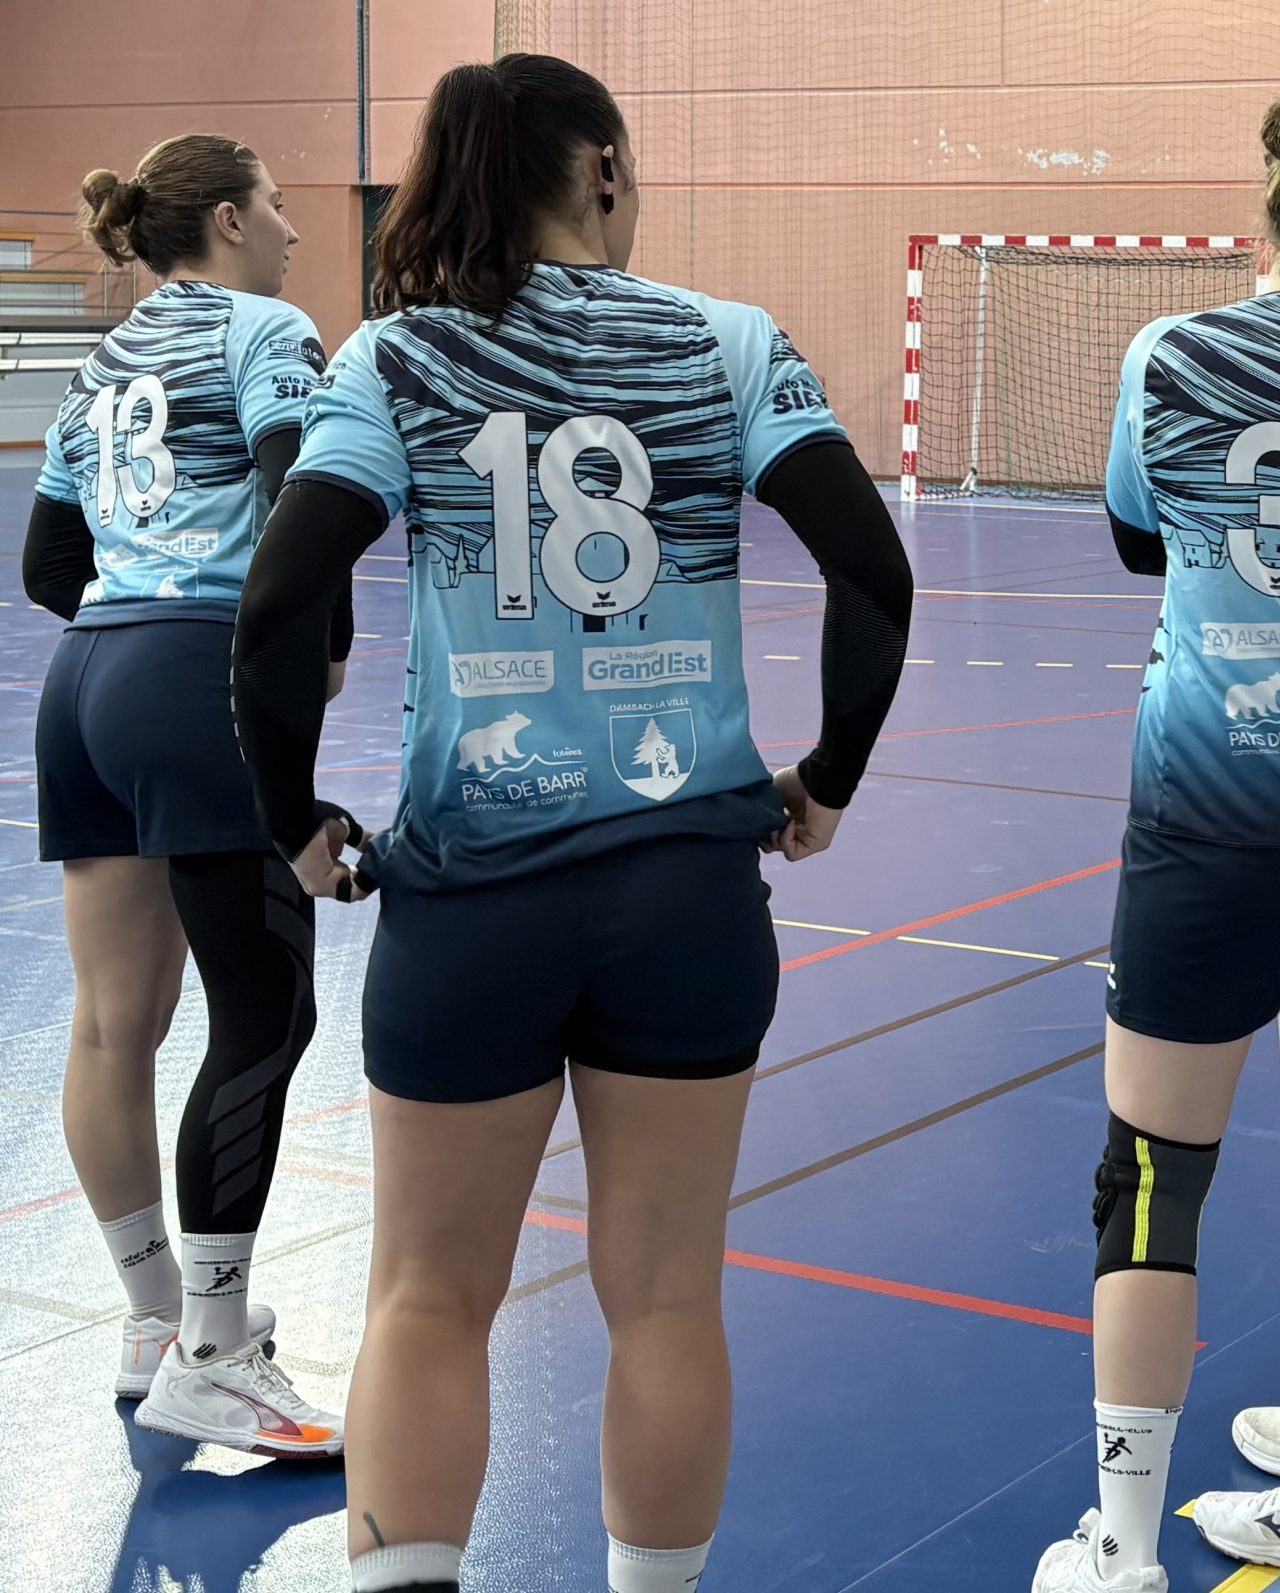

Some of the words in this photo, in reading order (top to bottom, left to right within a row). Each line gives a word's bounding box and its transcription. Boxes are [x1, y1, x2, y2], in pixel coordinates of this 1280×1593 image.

[86, 374, 176, 529] 13
[457, 411, 661, 621] 18
[473, 659, 547, 680] ALSACE
[1229, 731, 1266, 748] PAYS
[462, 783, 505, 802] PAYS
[507, 780, 535, 801] DE
[537, 771, 587, 794] BARR
